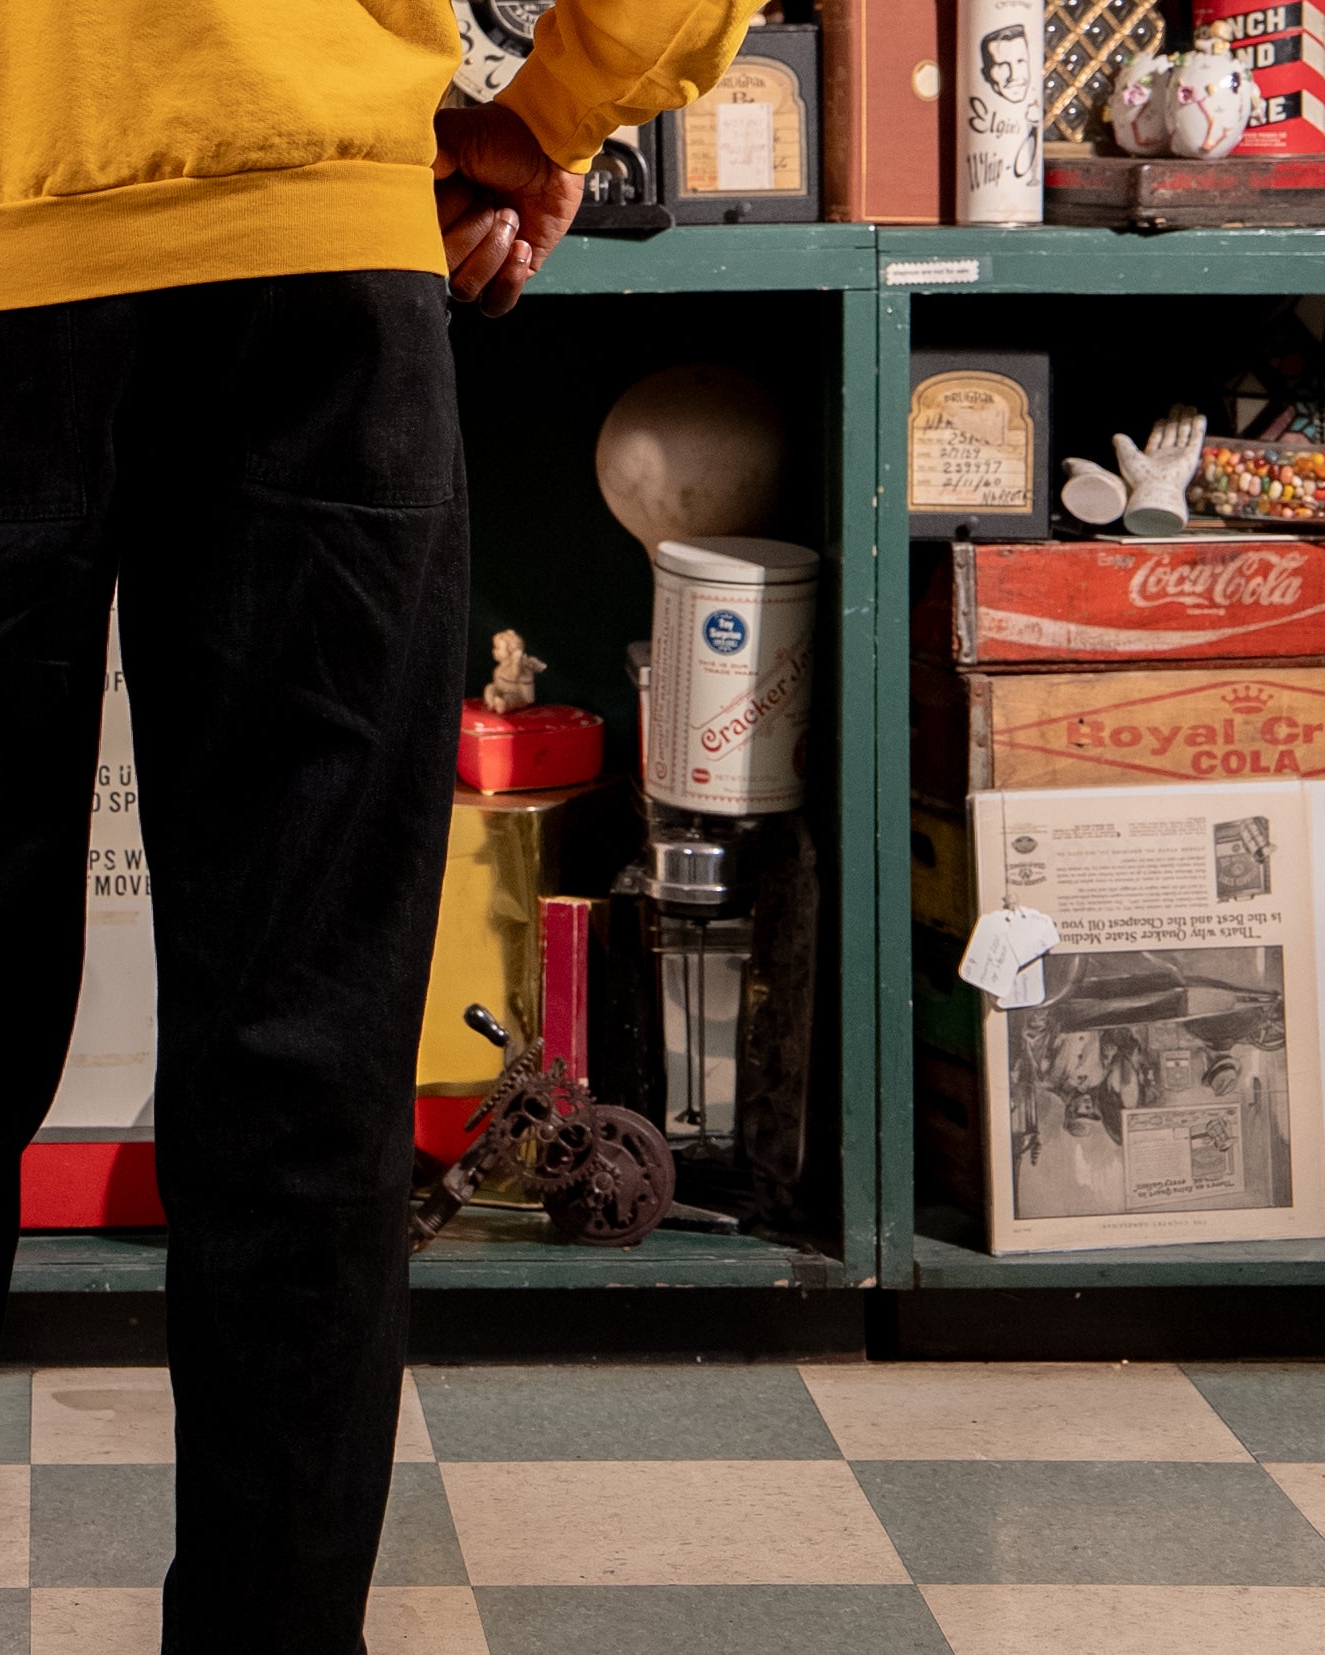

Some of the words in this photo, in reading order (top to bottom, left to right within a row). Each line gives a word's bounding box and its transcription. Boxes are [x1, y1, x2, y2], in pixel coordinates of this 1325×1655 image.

[1227, 6, 1287, 42] NCH
[1235, 41, 1276, 70] ND
[1130, 550, 1308, 608] Coca-Cola
[701, 679, 789, 753] Cracker
[1067, 717, 1236, 756] Royal
[1191, 749, 1301, 776] COLA
[87, 875, 151, 896] MOVE
[1061, 918, 1085, 930] you
[1108, 916, 1163, 929] Cheapest
[1166, 916, 1186, 928] the
[1190, 915, 1213, 927] and
[1217, 914, 1244, 926] Best
[1248, 913, 1267, 924] the
[1270, 912, 1281, 924] is
[1089, 919, 1105, 931] Oil
[1105, 931, 1137, 944] State
[1140, 927, 1186, 943] Quaker
[1191, 927, 1215, 941] why
